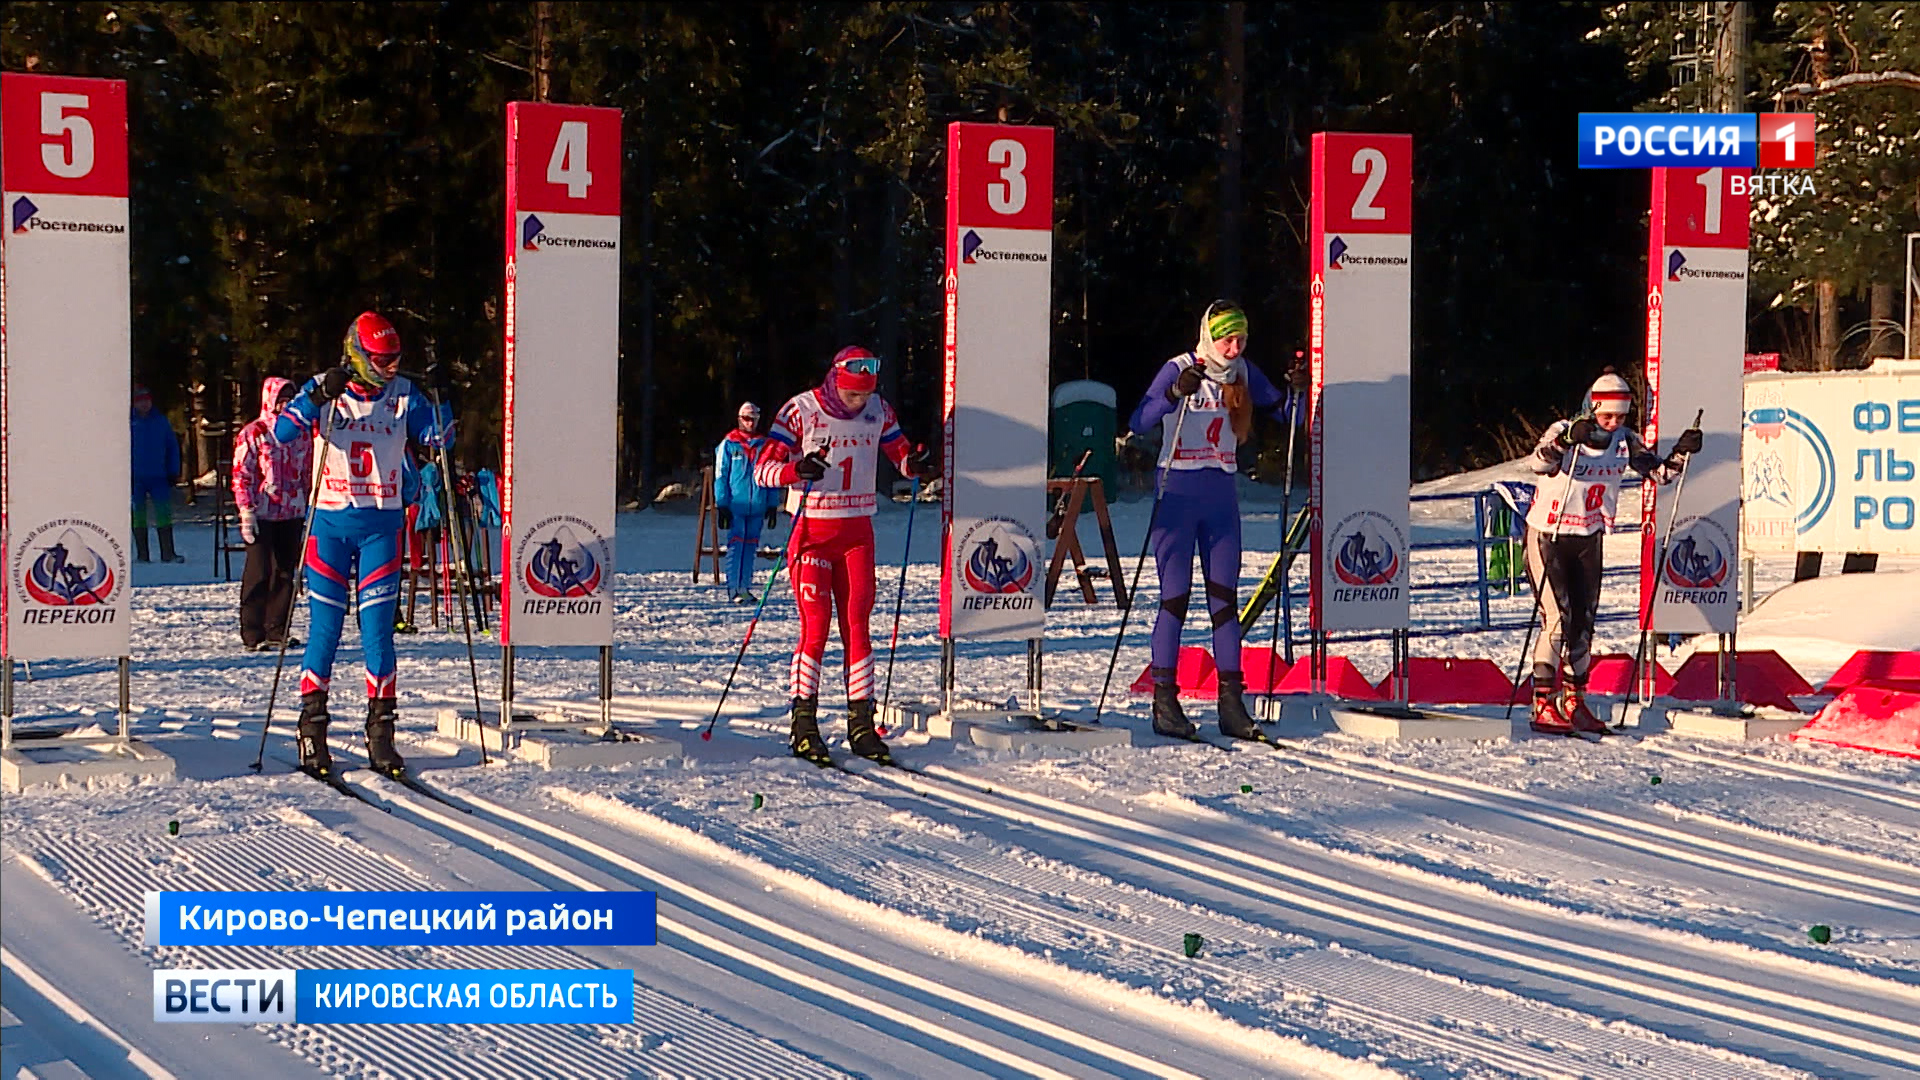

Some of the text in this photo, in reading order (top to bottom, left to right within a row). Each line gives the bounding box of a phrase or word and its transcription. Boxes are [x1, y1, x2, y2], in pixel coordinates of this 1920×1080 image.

[41, 92, 93, 178] 5
[547, 121, 593, 198] 4
[987, 139, 1027, 214] 3
[1351, 148, 1387, 220] 2
[1696, 167, 1723, 234] 1
[30, 217, 125, 233] Ростелеком
[537, 233, 617, 251] Ростелеком
[975, 247, 1048, 263] Ростелеком
[1340, 252, 1408, 267] Ростелеком
[1679, 266, 1745, 280] Ростелеком
[947, 294, 956, 346] ПЛЮС
[1312, 298, 1323, 348] ПЛЮС
[1648, 310, 1660, 358] ПЛЮС
[1206, 417, 1224, 448] 4
[350, 441, 374, 478] 5
[837, 455, 854, 491] 1
[1855, 449, 1915, 481] ЛЬ
[1585, 483, 1607, 512] 8
[1855, 496, 1915, 530] РО
[523, 599, 602, 615] ПЕРЕКОП
[962, 596, 1034, 611] ПЕРЕКОП
[1333, 587, 1400, 602] ПЕРЕКОП
[1664, 591, 1728, 604] ПЕРЕКОП
[23, 609, 116, 625] ПЕРЕКОП
